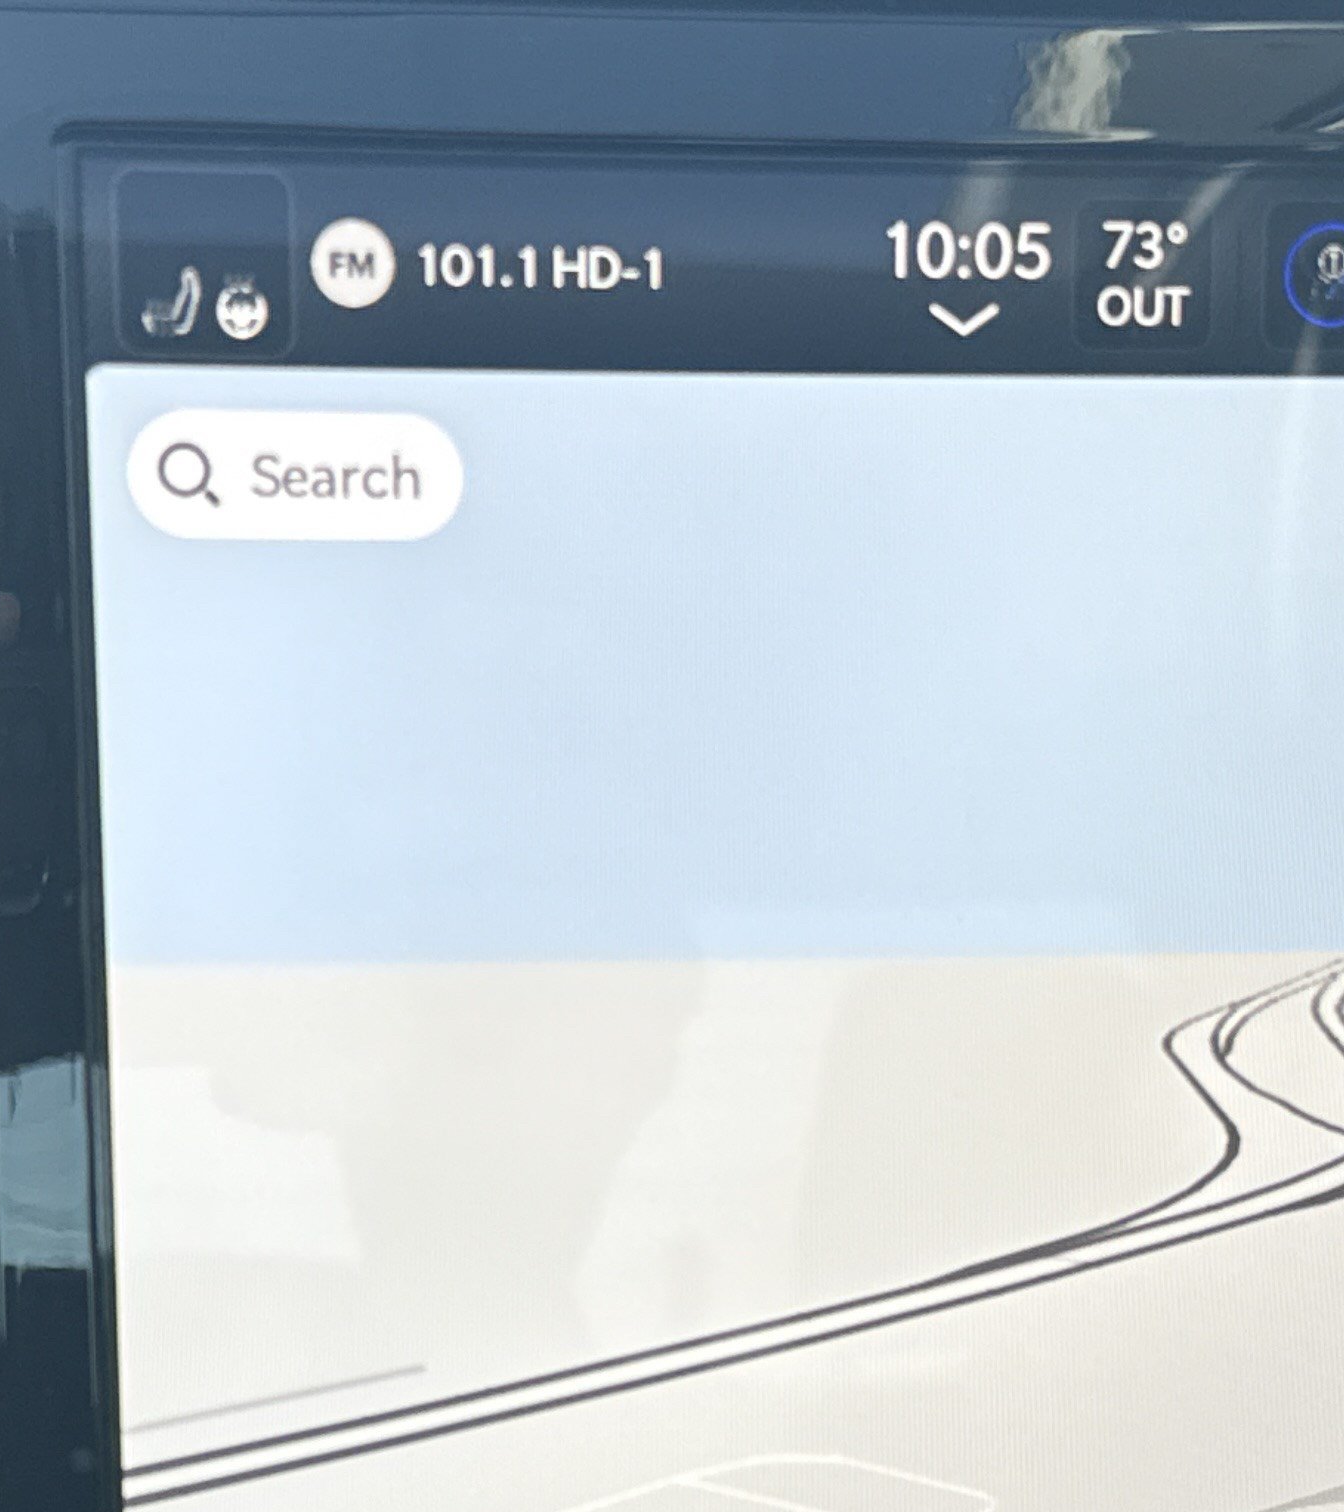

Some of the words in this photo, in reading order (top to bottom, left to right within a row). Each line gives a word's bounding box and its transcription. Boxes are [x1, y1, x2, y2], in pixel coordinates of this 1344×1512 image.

[328, 251, 375, 279] FM
[418, 243, 537, 289] 101.1
[552, 245, 662, 291] HD-1
[886, 220, 1051, 280] 10:05
[1097, 285, 1192, 327] OUT
[252, 454, 421, 500] Search
